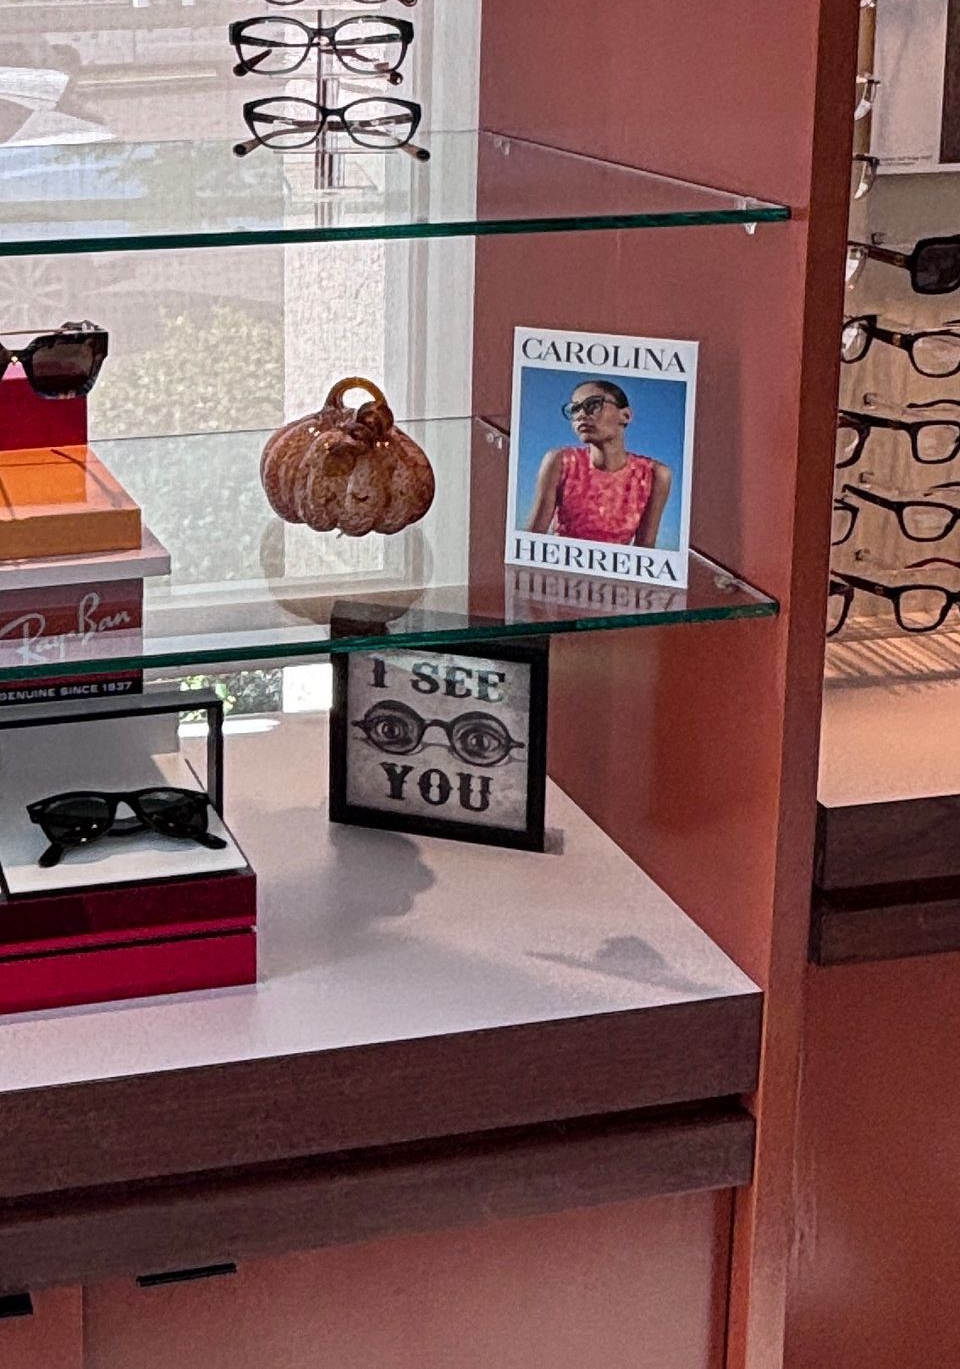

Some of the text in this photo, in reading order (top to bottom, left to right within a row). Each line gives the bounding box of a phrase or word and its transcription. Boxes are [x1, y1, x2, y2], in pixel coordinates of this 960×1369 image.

[521, 337, 686, 374] CAROLINA
[514, 538, 677, 581] HERRERA
[60, 683, 98, 697] SINCE
[369, 655, 506, 703] I SEE
[379, 761, 493, 812] YOU
